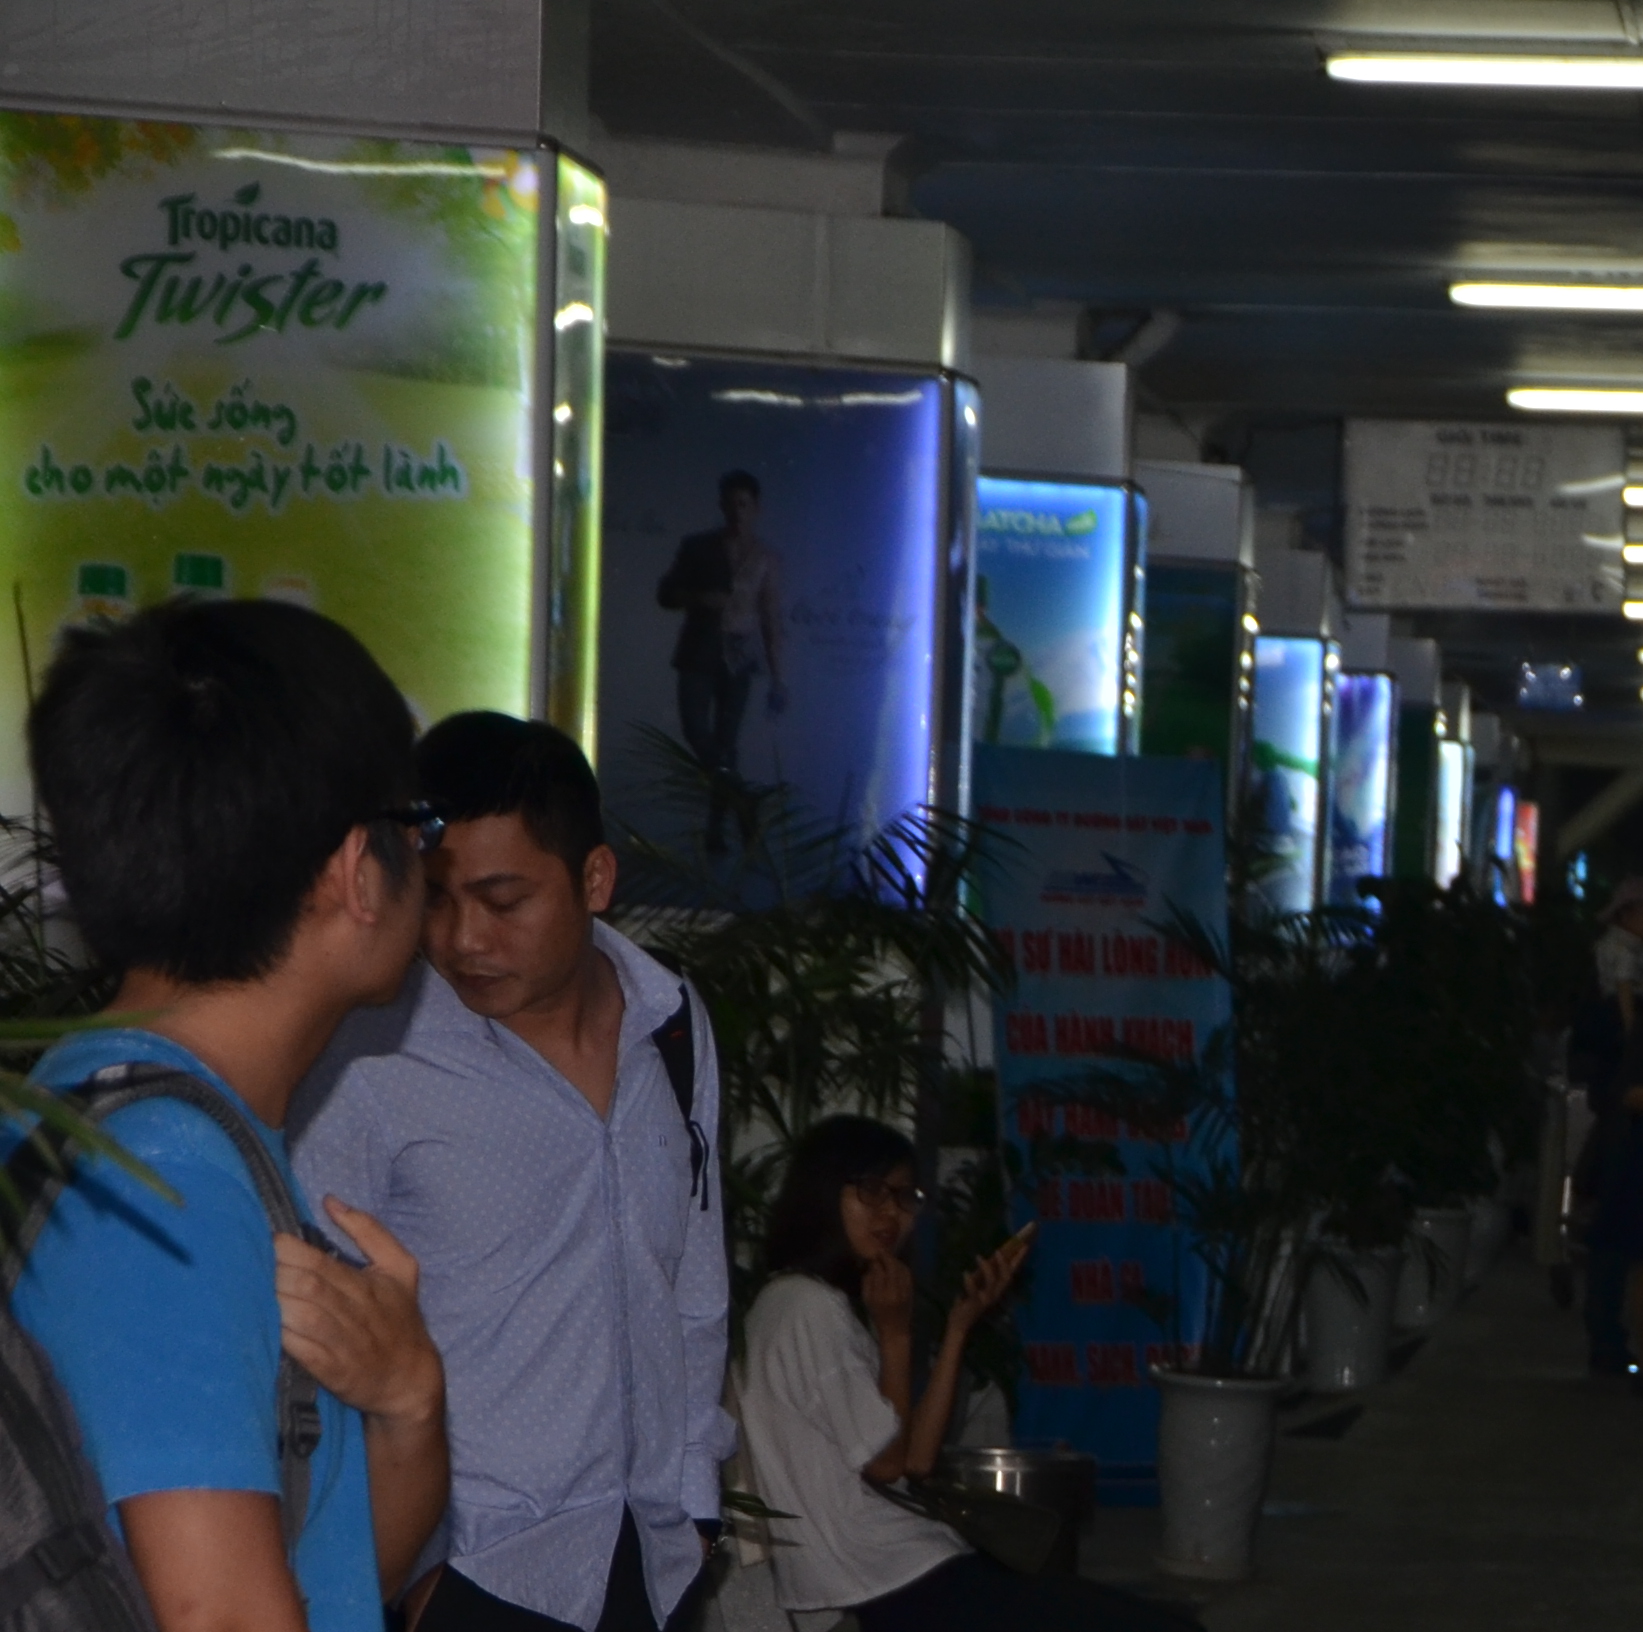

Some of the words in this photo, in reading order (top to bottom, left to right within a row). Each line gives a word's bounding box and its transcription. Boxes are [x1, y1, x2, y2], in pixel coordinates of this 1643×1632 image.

[158, 190, 340, 252] Tropicana
[114, 251, 389, 345] Twister
[131, 376, 196, 431] Sức
[207, 379, 296, 446] sống
[25, 443, 94, 496] cho
[104, 443, 190, 507] một
[203, 450, 292, 510] ngày
[300, 440, 371, 493] tốt
[383, 441, 461, 493] lành
[977, 509, 1064, 537] ATCHA
